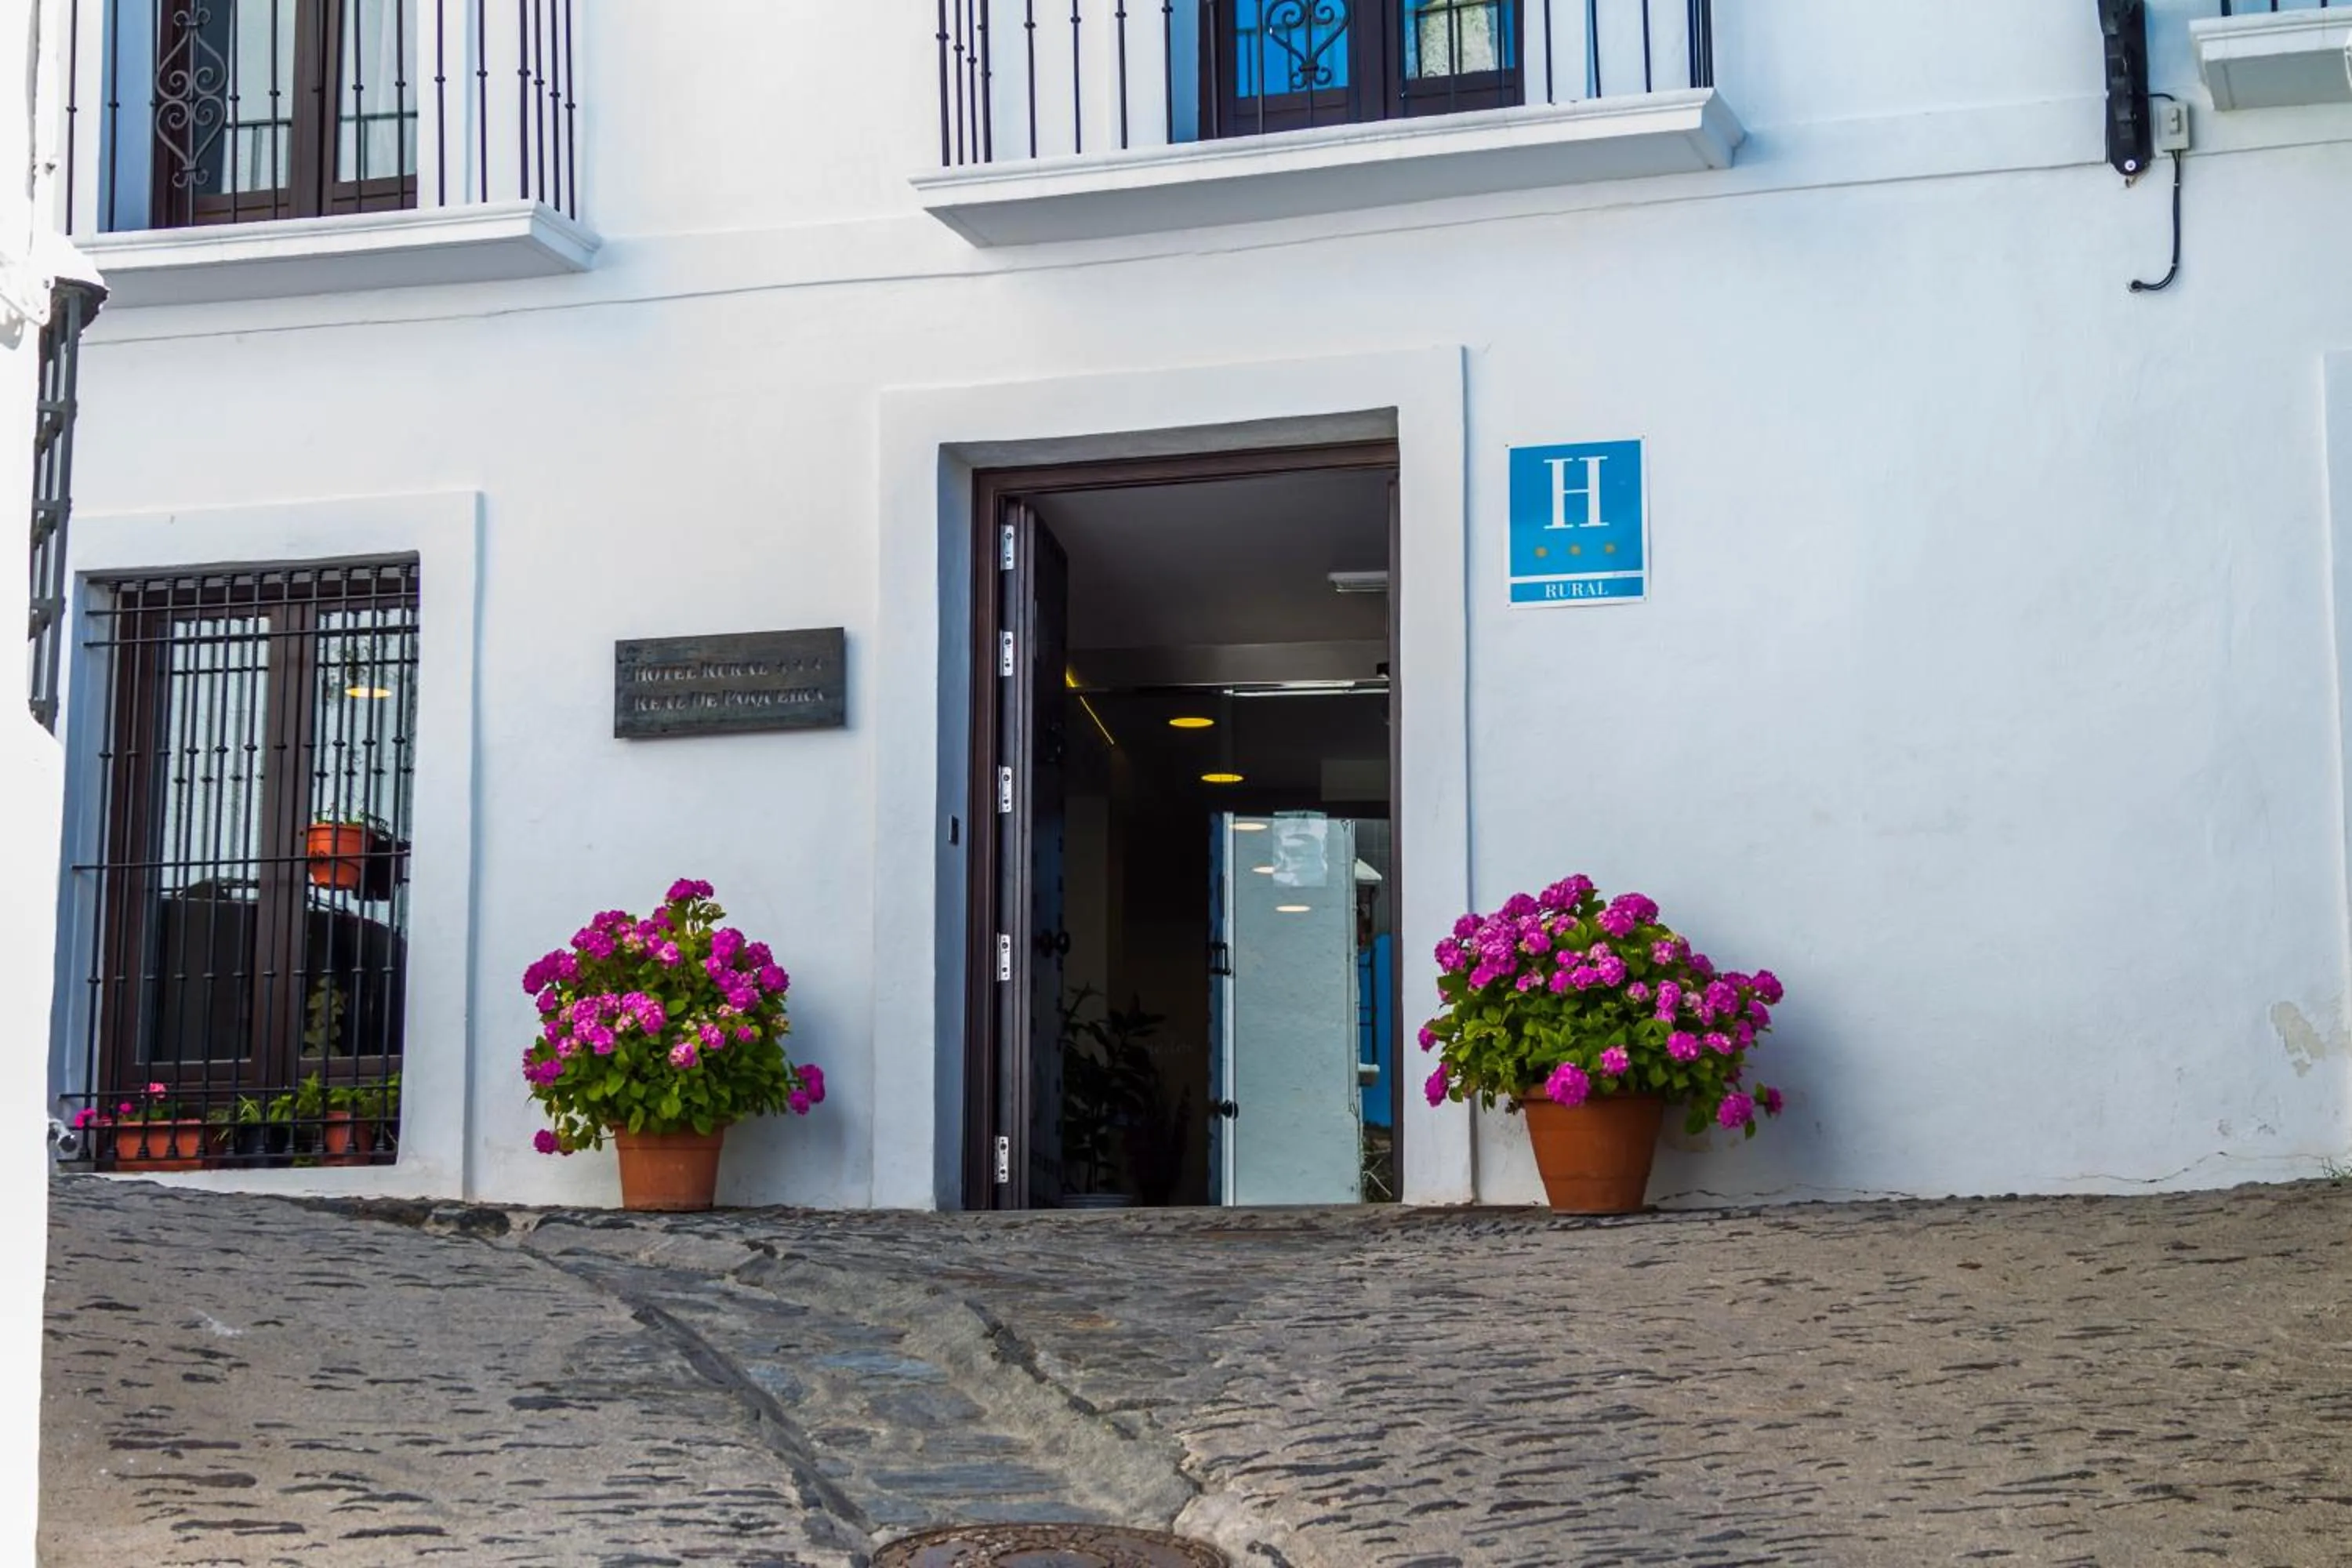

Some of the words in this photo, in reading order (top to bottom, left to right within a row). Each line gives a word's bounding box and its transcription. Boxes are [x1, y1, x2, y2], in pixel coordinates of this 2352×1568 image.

[1543, 456, 1610, 529] H
[1544, 581, 1609, 598] RURAL
[634, 664, 697, 682] HOTEL
[701, 661, 769, 678] RURAL
[692, 691, 717, 708] DE
